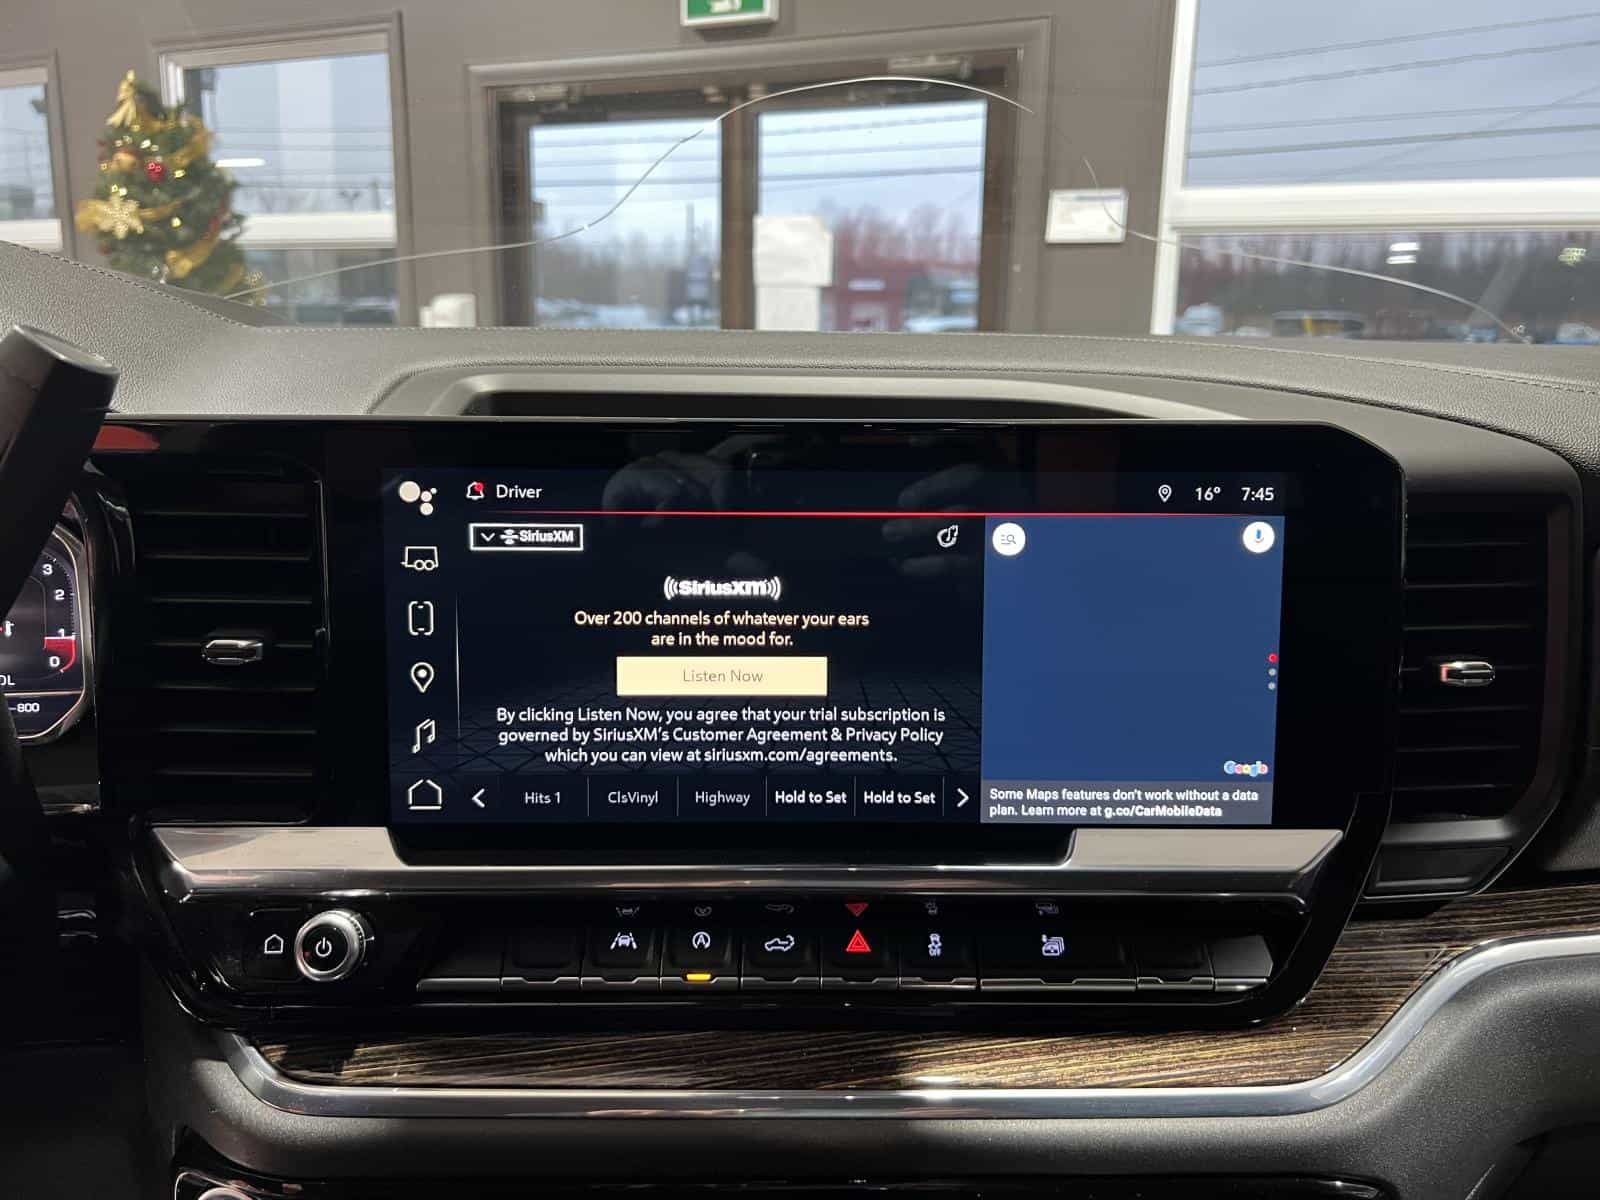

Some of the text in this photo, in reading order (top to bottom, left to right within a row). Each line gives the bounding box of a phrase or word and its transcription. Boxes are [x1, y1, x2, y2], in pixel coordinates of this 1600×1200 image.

[495, 483, 543, 499] Driver
[1241, 486, 1275, 502] 7:45
[520, 530, 574, 542] SiriusXM
[43, 563, 53, 575] 3
[55, 589, 65, 601] 2
[574, 609, 870, 630] Over 200 channels of whatever your ears
[650, 630, 794, 647] are in the mood for.
[683, 669, 763, 682] Listen Now
[496, 705, 946, 726] By clicking Listen Now, you agree that your trial subscription is
[497, 726, 944, 747] governed by SiriusXM's Customer Agreement & Privacy Policy
[544, 746, 898, 767] which you can view at siriusxm.com/agreements.
[524, 791, 561, 804] Hits 1
[607, 790, 659, 807] ClsVinyl
[695, 790, 751, 807] Highway
[775, 789, 847, 804] Hold to Set
[863, 790, 936, 804] Hold to Set
[989, 787, 1259, 803] Some Maps features don't work without a data
[989, 803, 1223, 819] plan. Learn more at g.co/CarMobileData
